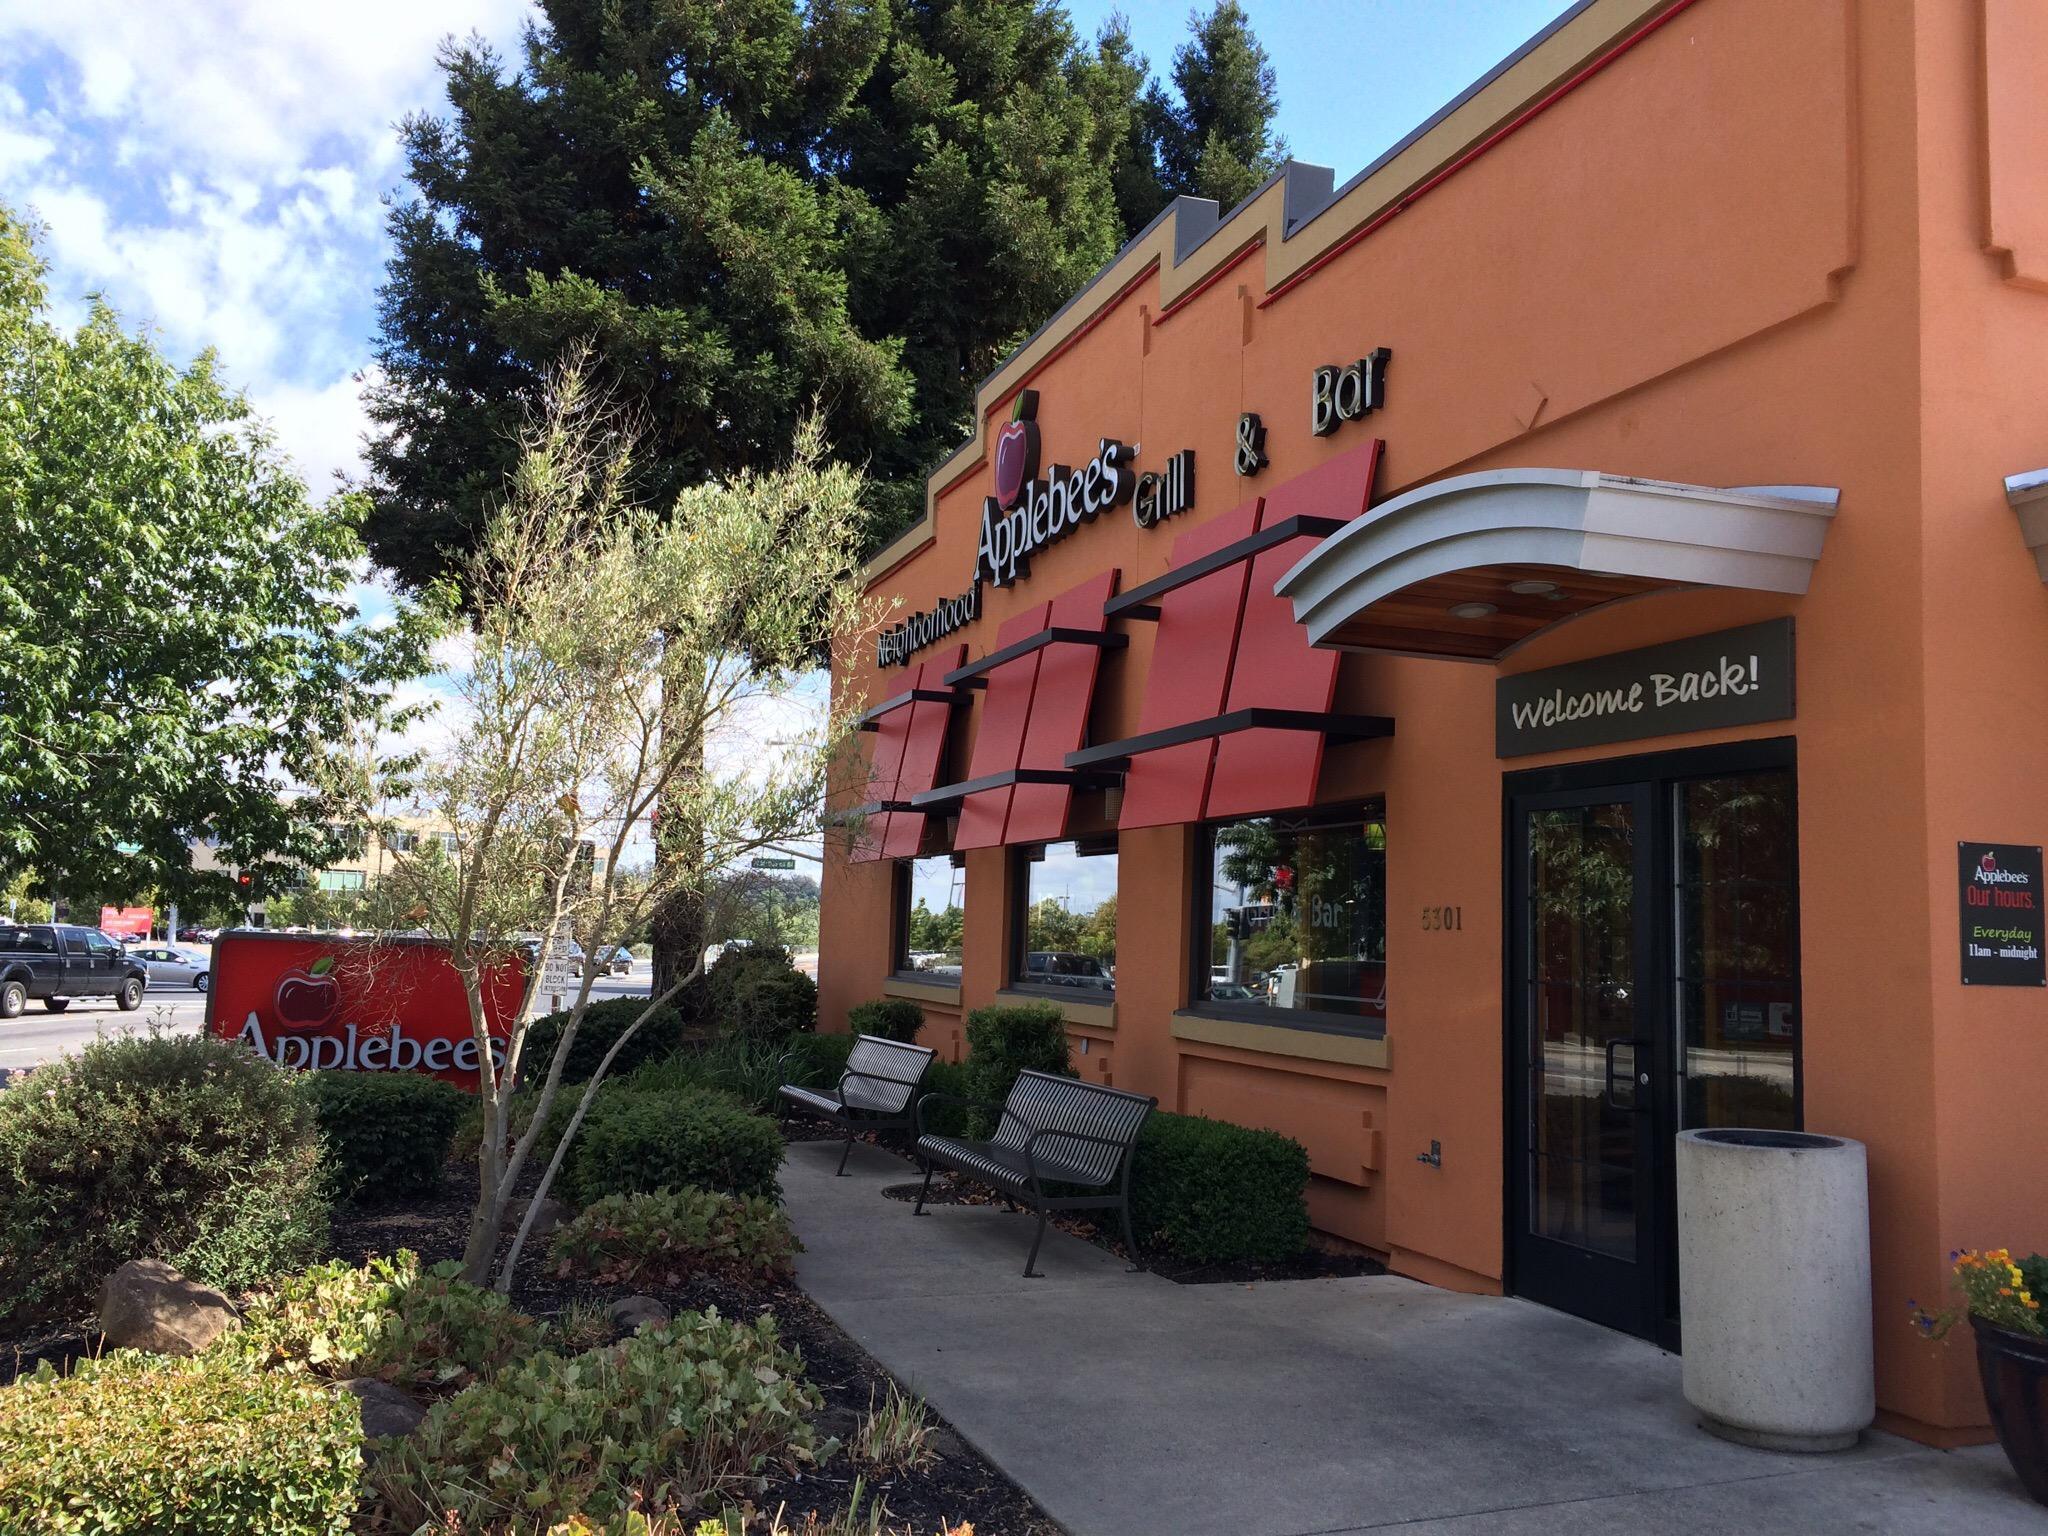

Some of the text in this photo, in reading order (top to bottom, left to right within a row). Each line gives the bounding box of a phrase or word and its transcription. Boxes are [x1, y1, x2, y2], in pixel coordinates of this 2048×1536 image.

[1312, 348, 1389, 437] Bar
[1235, 412, 1268, 476] &
[1132, 450, 1195, 529] Grill
[973, 438, 1130, 588] Applebee's
[877, 580, 982, 668] Neighborhood
[1512, 655, 1759, 730] Welcome Back!
[1974, 865, 2029, 884] Applebee's
[1311, 894, 1343, 929] Bar
[1967, 885, 2036, 909] Our hours.
[1422, 906, 1462, 931] 5301
[1973, 926, 2032, 943] Everyday
[1969, 944, 1991, 957] 11am
[1999, 945, 2038, 960] midnight
[545, 975, 566, 984] BLOCK
